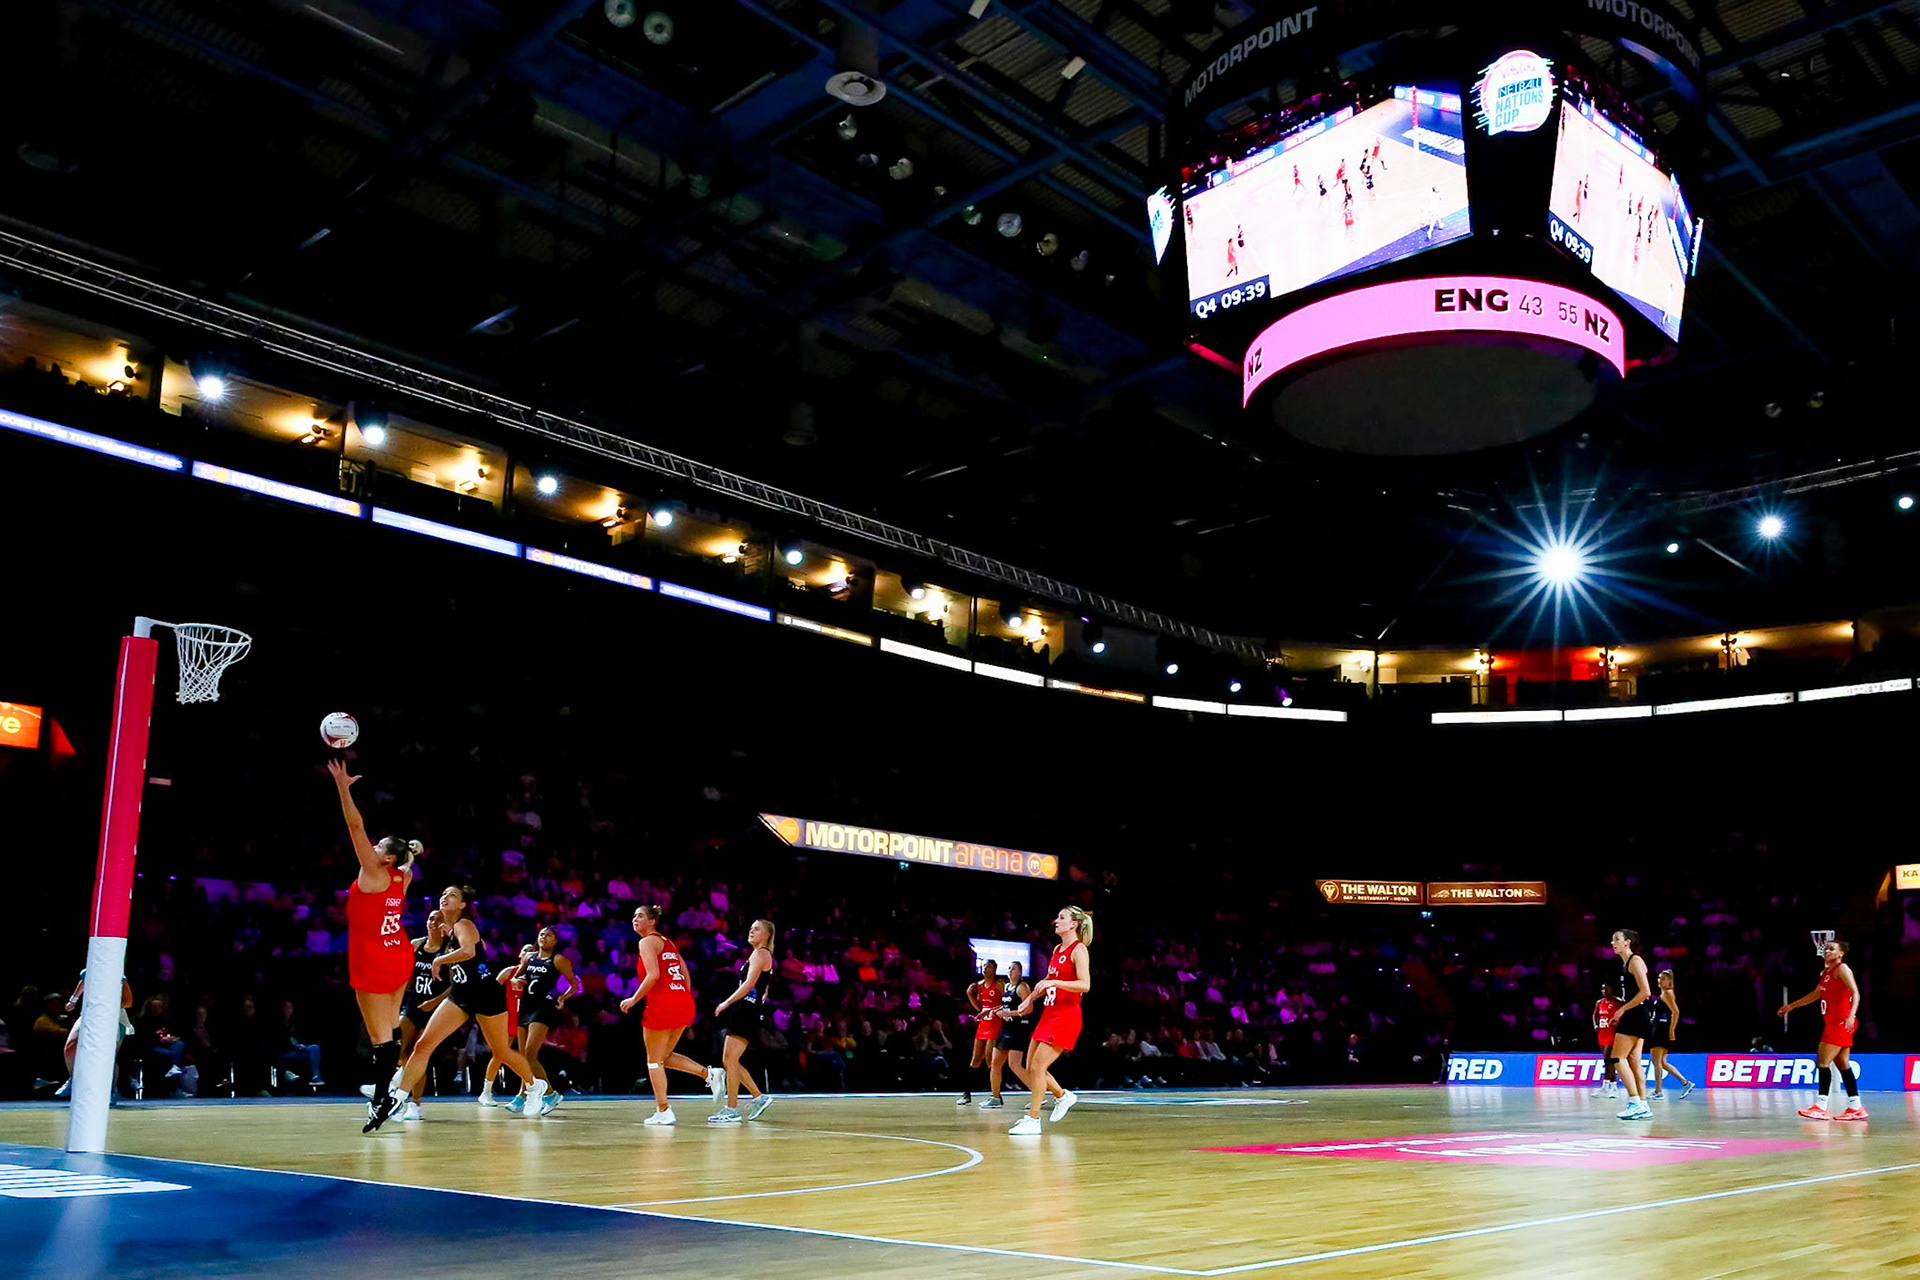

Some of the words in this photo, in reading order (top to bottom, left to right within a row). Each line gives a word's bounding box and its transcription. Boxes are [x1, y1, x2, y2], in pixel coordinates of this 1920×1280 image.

[1587, 0, 1701, 74] MOTORPOINT
[1184, 6, 1318, 108] MOTORPOINT
[1497, 77, 1543, 98] NETBALL
[1495, 89, 1544, 114] NATIONS
[1494, 108, 1520, 128] CUP
[1550, 219, 1564, 242] Q4
[1564, 231, 1592, 264] 09:39
[1195, 297, 1217, 319] Q4
[1220, 281, 1266, 309] 09:39
[1434, 288, 1510, 313] ENG
[1518, 294, 1544, 316] 43
[1558, 301, 1580, 325] 55
[1584, 308, 1611, 344] NZ
[1247, 346, 1264, 384] NZ
[33, 422, 68, 439] FROM
[138, 450, 155, 461] OF
[154, 454, 183, 469] CARS
[554, 554, 630, 584] MOTORPOINT
[804, 822, 954, 864] MOTORPOINT
[954, 842, 1023, 874] arena
[1902, 870, 1919, 878] KA
[1340, 883, 1365, 895] THE
[1366, 884, 1417, 896] WALTON
[1450, 888, 1473, 898] THE
[1474, 888, 1523, 898] WALTON
[415, 962, 432, 971] myo
[526, 964, 548, 974] myob
[415, 976, 433, 995] GK
[528, 978, 539, 994] C
